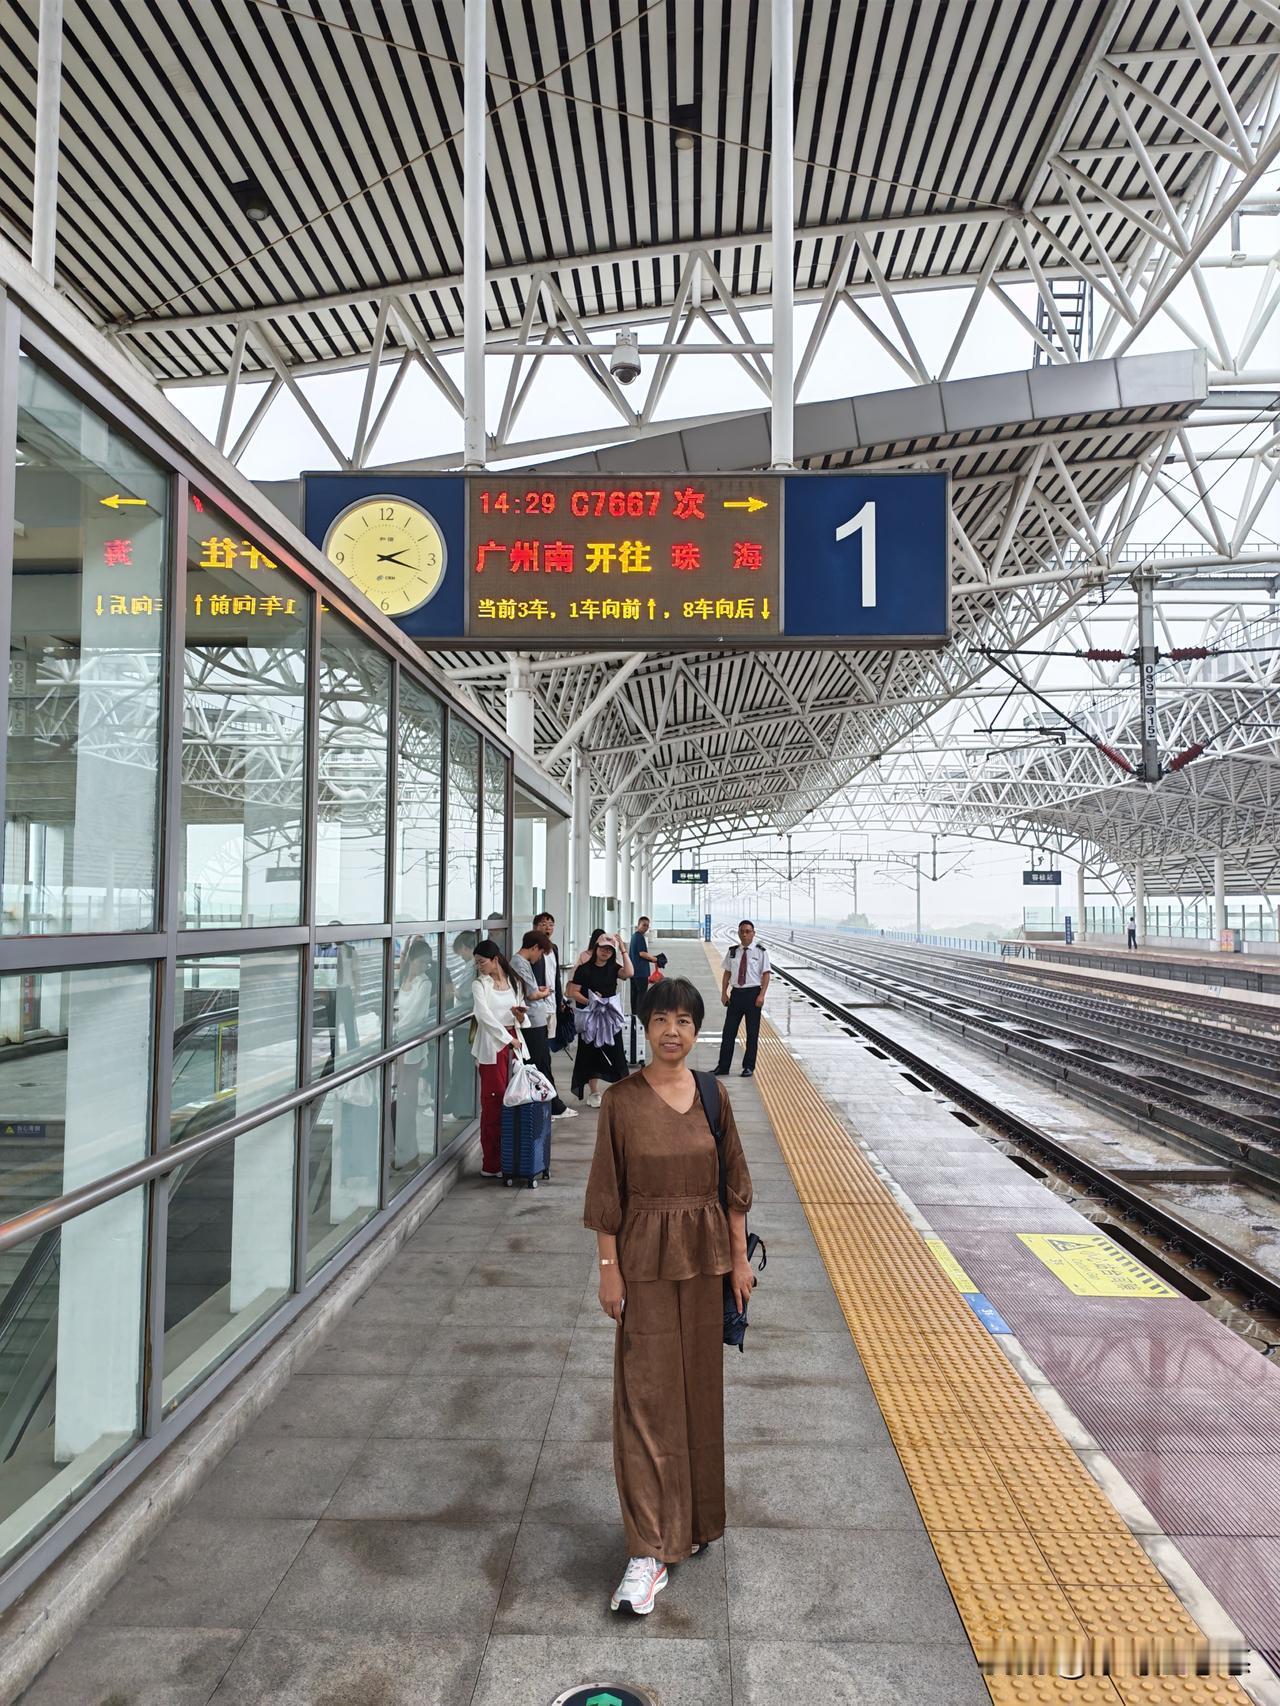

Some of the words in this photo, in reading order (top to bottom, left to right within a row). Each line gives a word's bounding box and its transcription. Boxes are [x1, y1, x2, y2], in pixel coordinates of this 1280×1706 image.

[480, 492, 556, 514] 14:29
[571, 490, 661, 517] C7667
[672, 487, 705, 520] 次
[379, 507, 394, 521] 12
[335, 551, 345, 565] 9
[426, 552, 436, 567] 3
[475, 540, 575, 573] 广州南
[585, 540, 653, 573] 开往
[835, 500, 877, 608] 1
[380, 597, 390, 611] 6
